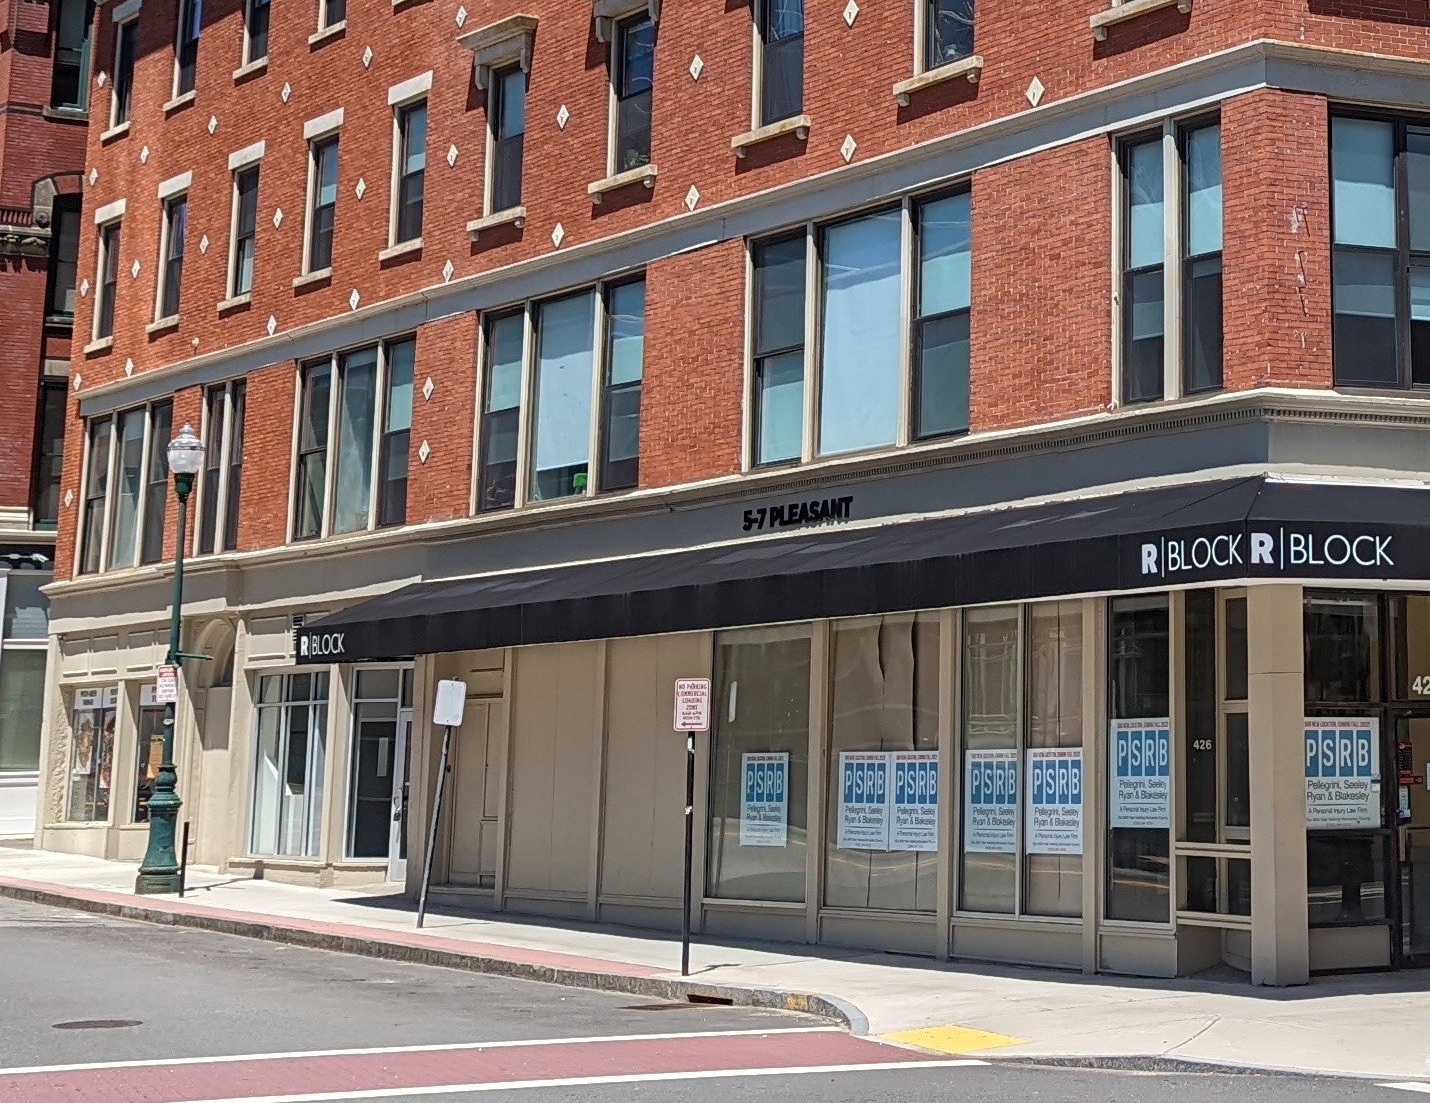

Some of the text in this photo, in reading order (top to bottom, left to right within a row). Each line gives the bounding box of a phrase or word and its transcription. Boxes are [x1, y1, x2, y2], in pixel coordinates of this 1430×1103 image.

[743, 496, 854, 531] 5-7 PLEASANT
[1142, 534, 1243, 574] R BLOCK
[1250, 532, 1395, 566] R BLOCK
[300, 633, 345, 657] R BLOCK
[1118, 738, 1168, 767] PSRB
[1192, 739, 1212, 750] 426
[1306, 738, 1369, 767] PSRB
[746, 770, 783, 794] PSRB
[844, 770, 885, 795] PSRB
[896, 770, 937, 795] PSRB
[972, 769, 1016, 795] PSRB
[1033, 768, 1080, 795] PSRB
[1344, 779, 1368, 790] Seeley
[1307, 791, 1369, 802] Ryan & Blakesley
[1034, 817, 1048, 828] Ryan
[1050, 817, 1054, 826] &
